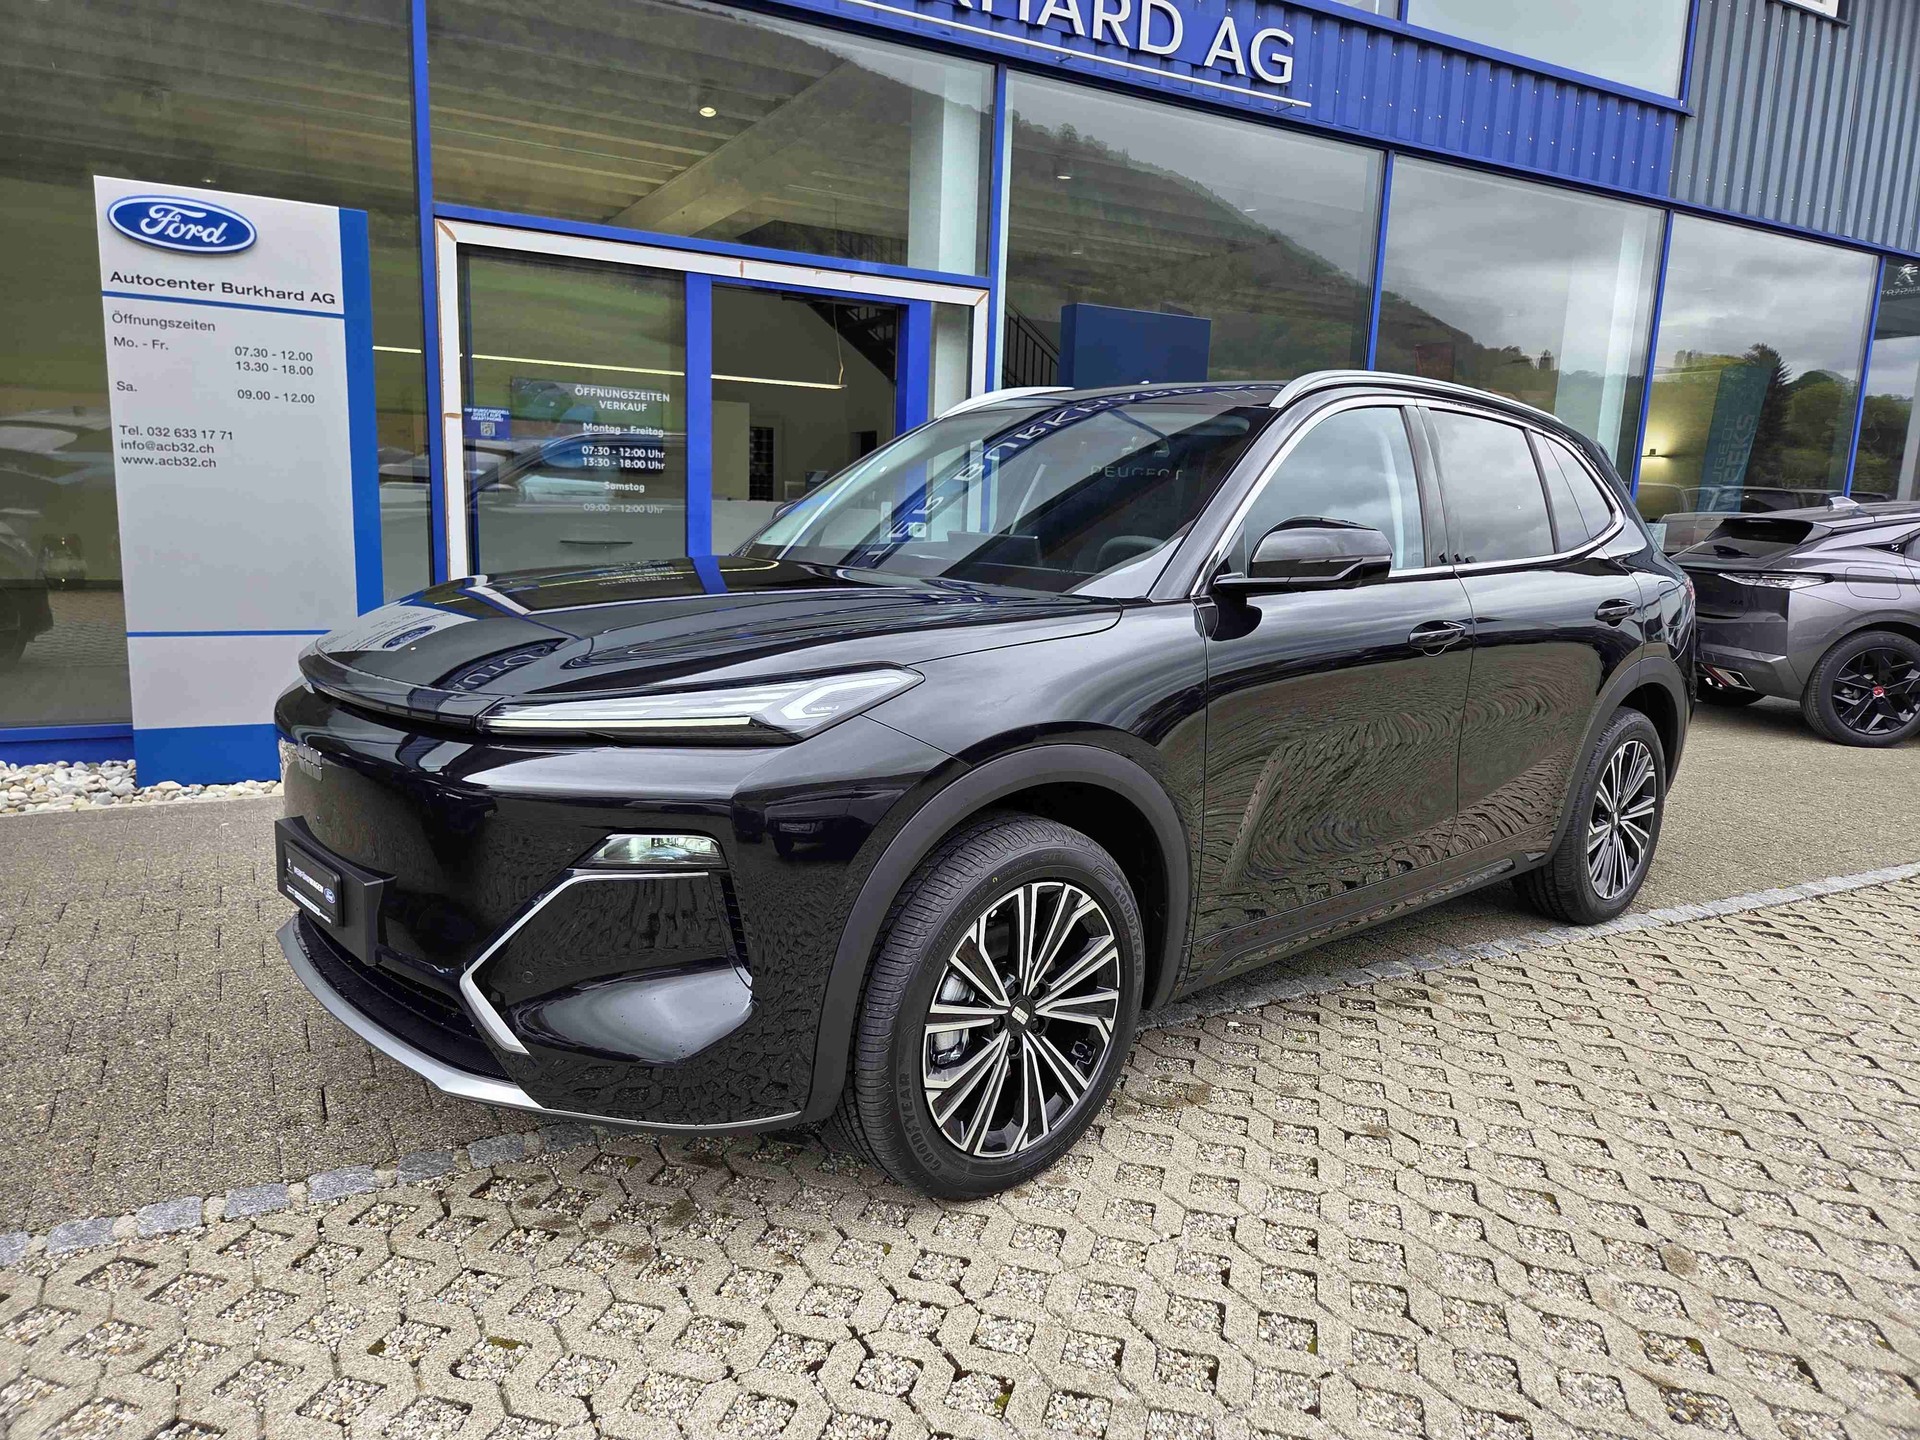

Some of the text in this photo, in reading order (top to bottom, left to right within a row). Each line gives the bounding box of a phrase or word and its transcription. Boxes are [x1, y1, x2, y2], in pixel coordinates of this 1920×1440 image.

[958, 0, 1295, 84] ARD AG
[140, 204, 228, 244] Ford
[110, 271, 336, 305] Autocenter Burkhard AG
[111, 310, 216, 332] Öffnungszeiten
[113, 336, 139, 349] Mo.
[151, 338, 169, 351] Fr.
[234, 345, 268, 359] 07.30
[281, 350, 313, 362] 12.00
[236, 361, 269, 373] 13.30
[282, 364, 314, 376] 18.00
[116, 380, 138, 393] Sa.
[574, 384, 670, 403] ÖFFNUNGSZEITEN
[237, 389, 271, 401] 09.00
[284, 392, 315, 404] 12.00
[599, 400, 648, 412] VERKAUF
[119, 424, 233, 441] Tel. 032 633 17 71
[582, 422, 621, 436] Montag
[629, 425, 664, 438] Freitag
[120, 440, 215, 454] info@acb32.ch
[581, 445, 610, 457] 07:30
[619, 447, 646, 459] 12:00
[648, 448, 666, 459] Uhr
[122, 455, 217, 469] www.acb32.ch
[582, 457, 610, 468] 13:30
[620, 459, 646, 470] 18:00
[648, 460, 666, 471] Uhr
[602, 481, 646, 494] Samstag
[583, 503, 611, 514] 09:00
[620, 504, 646, 515] 12:00
[647, 505, 665, 515] Uhr
[899, 1071, 942, 1171] GOODYEAR
